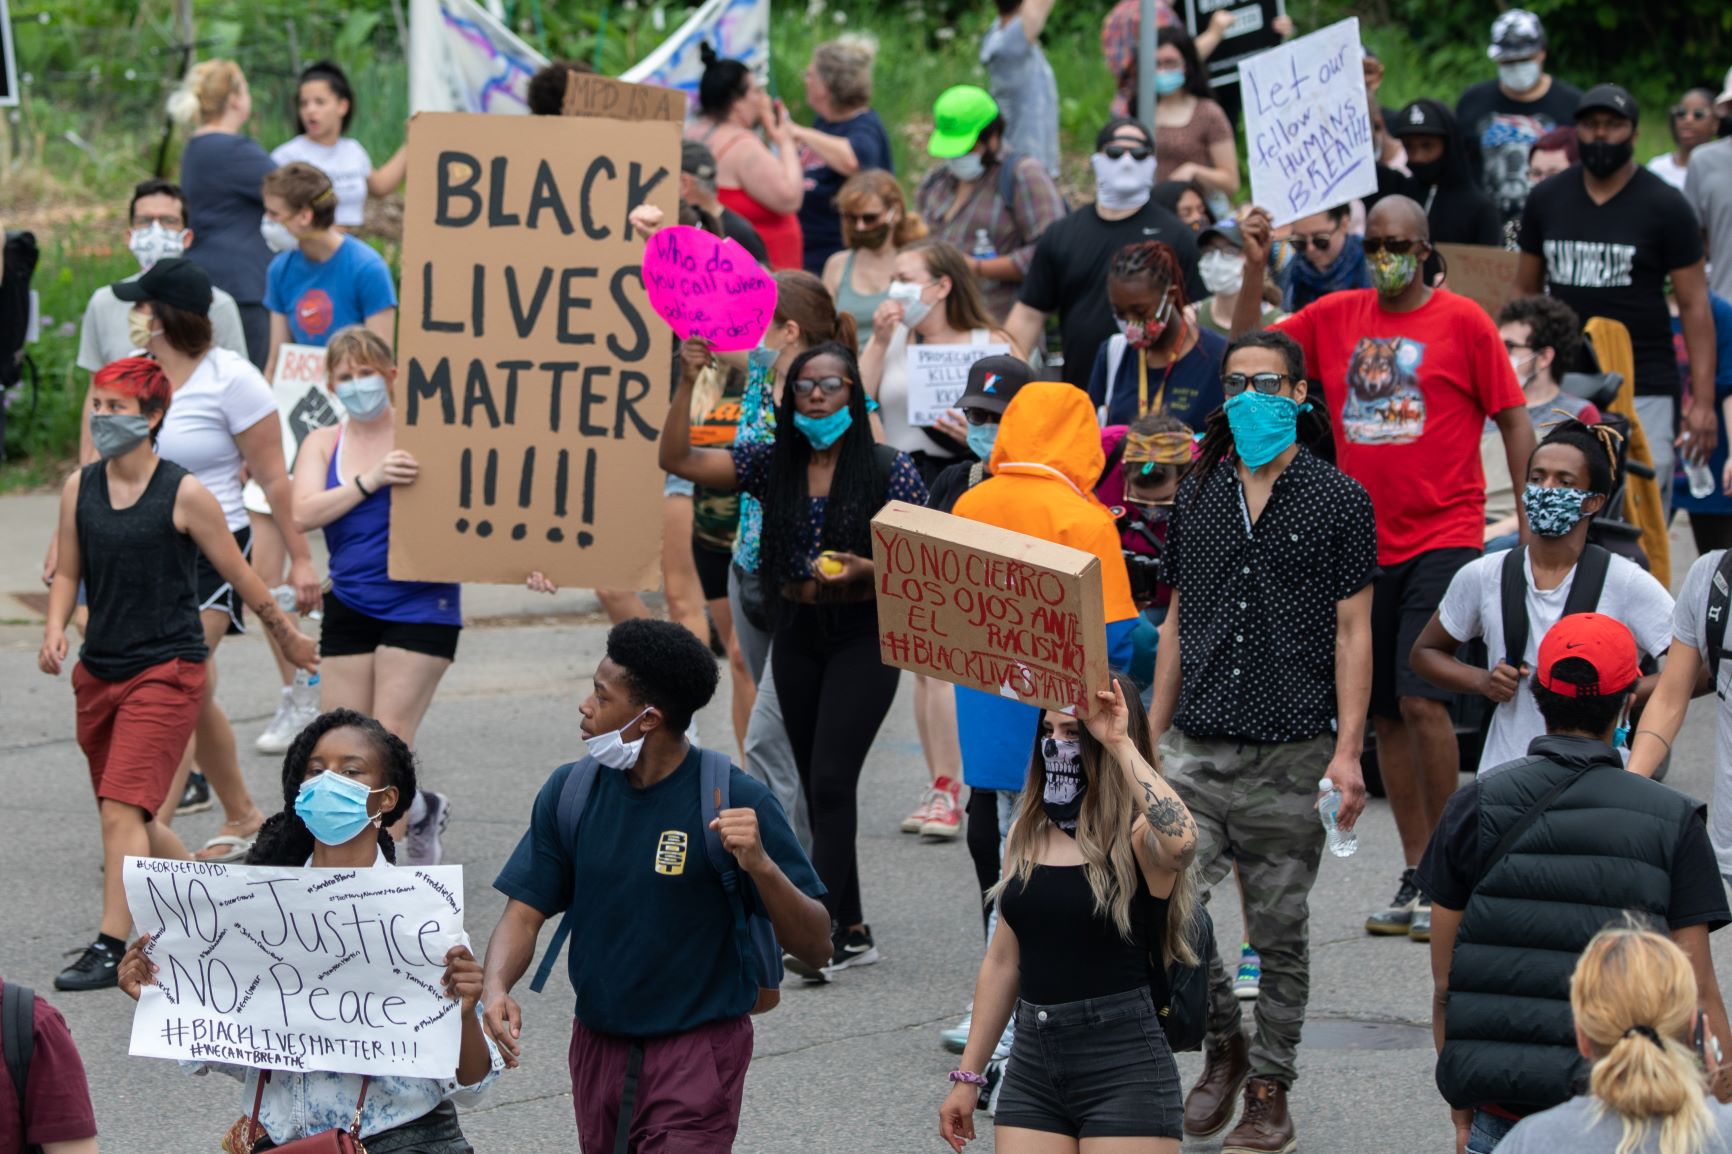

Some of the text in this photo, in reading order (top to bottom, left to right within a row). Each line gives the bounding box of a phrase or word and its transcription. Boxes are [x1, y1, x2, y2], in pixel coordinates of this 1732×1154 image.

[571, 76, 671, 120] MPD IS A
[1248, 44, 1347, 115] Let our
[1256, 108, 1311, 168] fellow
[1279, 98, 1356, 179] HUMANS
[1288, 114, 1370, 213] BREATHE
[435, 151, 669, 241] BLACK
[655, 233, 734, 273] Who do
[681, 273, 717, 297] call
[725, 276, 766, 295] when
[422, 262, 651, 362] LIVES
[689, 308, 764, 339] murder?
[406, 357, 660, 441] MATTER
[455, 446, 597, 548] !!!!!
[876, 530, 1065, 606] YO NO CIERRO
[882, 573, 1083, 647] LOS OJOS ANTE
[908, 605, 1085, 676] EL RACISMO
[137, 860, 229, 877] #GEORGEFLOYD!
[147, 873, 448, 968] NO Justice
[169, 954, 409, 1029] NO Peace
[190, 1041, 305, 1068] #WECANTBREATHE
